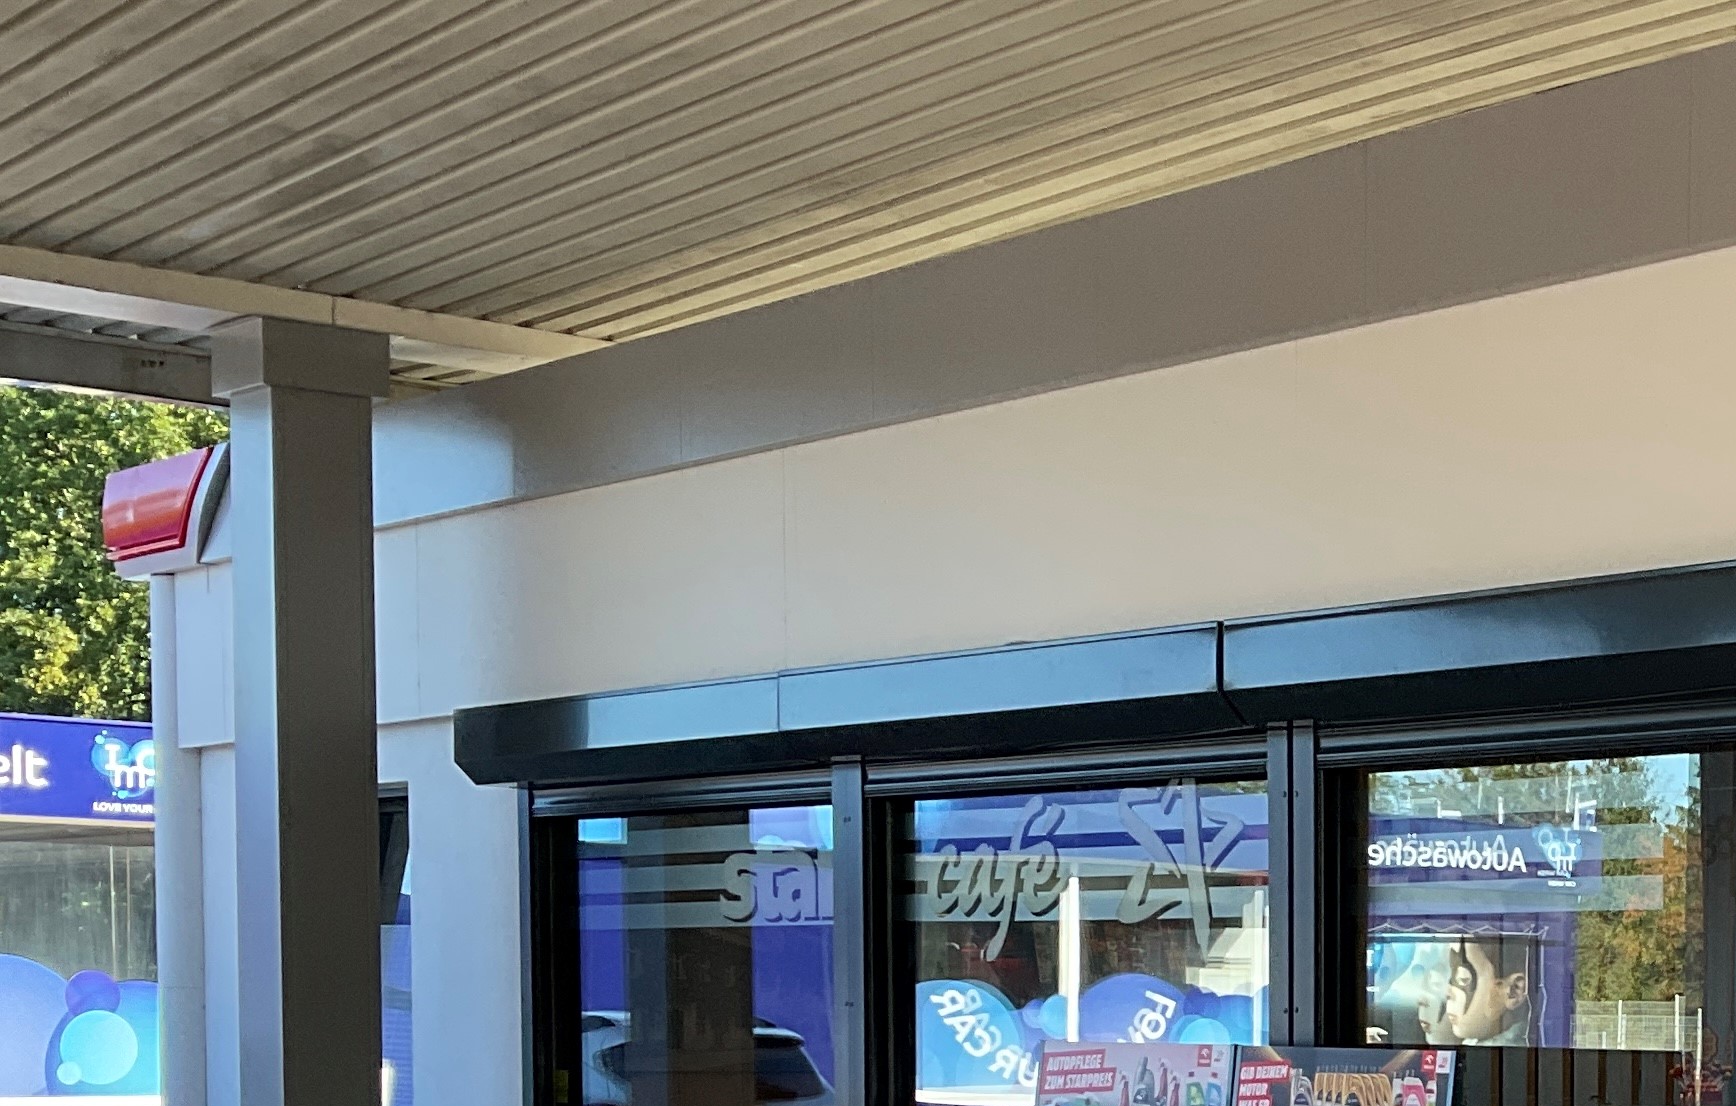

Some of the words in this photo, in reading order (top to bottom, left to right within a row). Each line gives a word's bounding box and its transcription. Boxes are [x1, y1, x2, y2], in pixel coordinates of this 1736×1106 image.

[1046, 1053, 1103, 1071] AUTOPFLEGE
[1044, 1074, 1065, 1090] ZUM
[1065, 1071, 1114, 1089] STARPREIS
[1239, 1083, 1268, 1096] MOTOR
